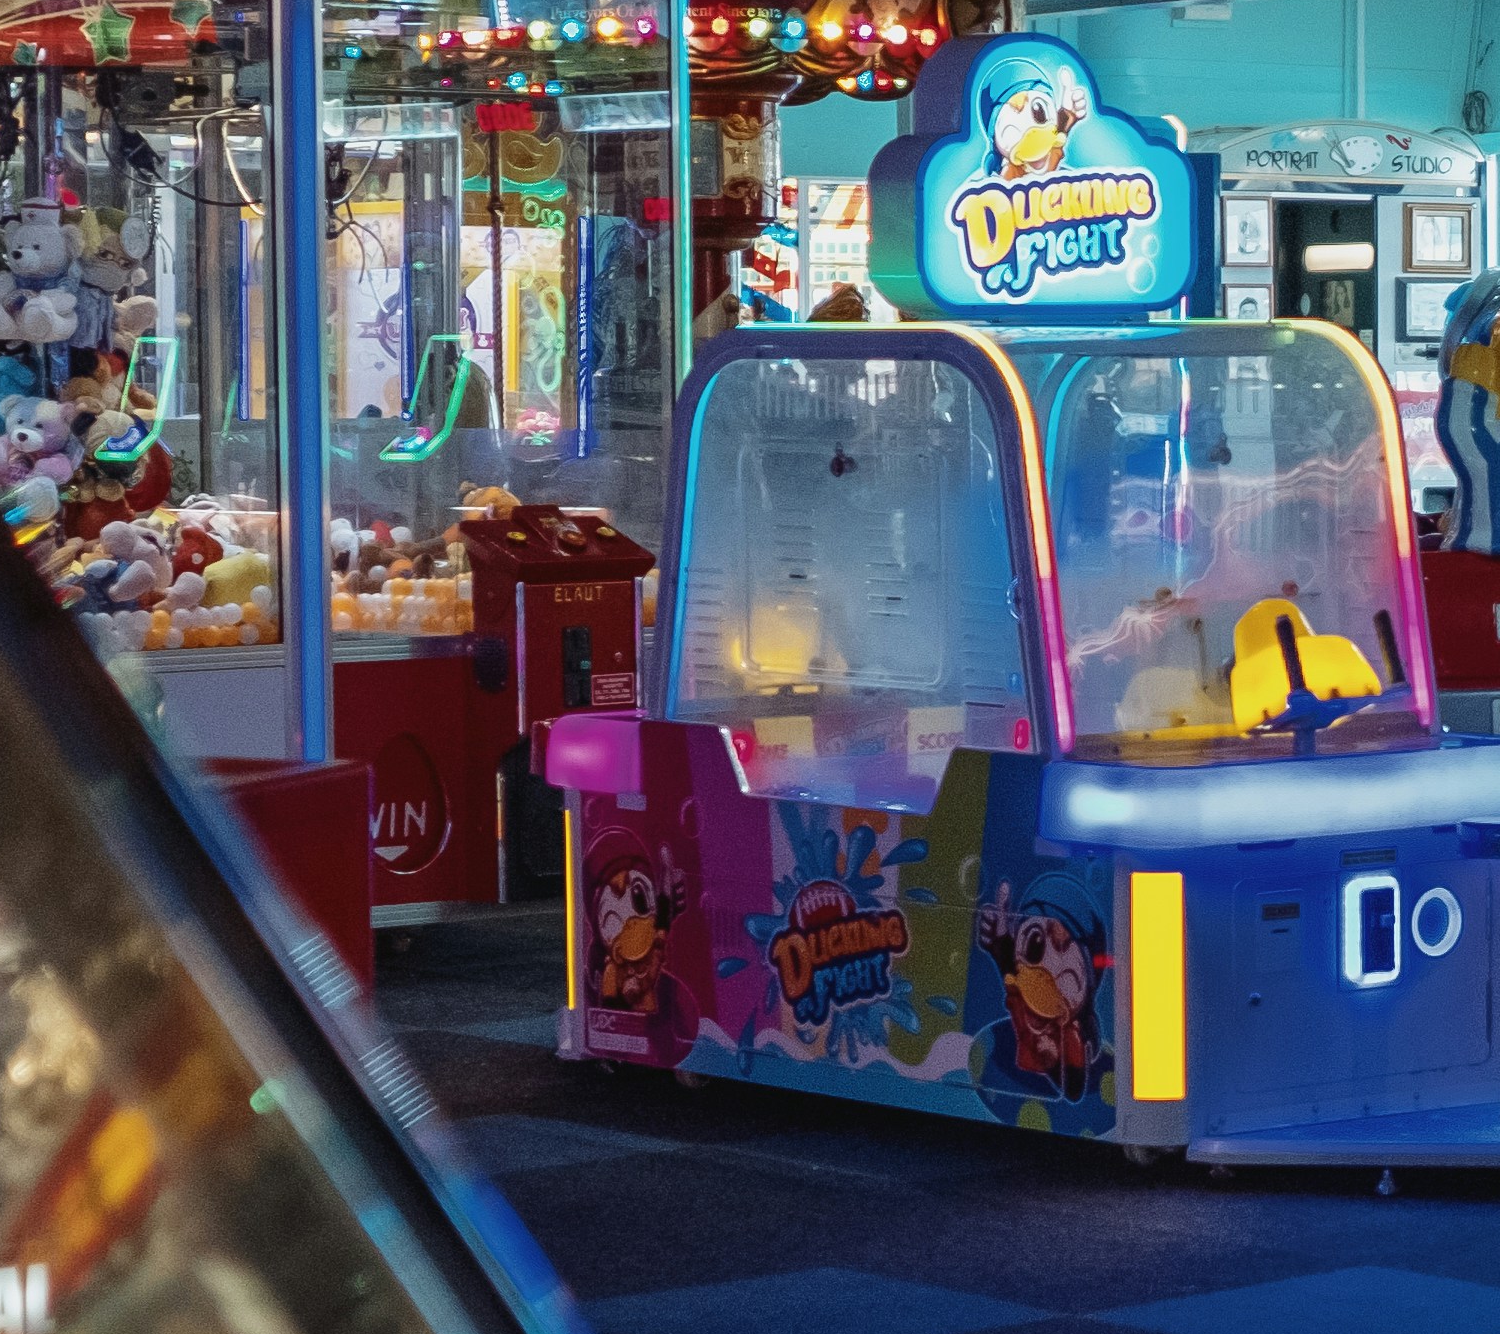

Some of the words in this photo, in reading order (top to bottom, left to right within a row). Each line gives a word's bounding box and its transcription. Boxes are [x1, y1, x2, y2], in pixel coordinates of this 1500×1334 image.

[1246, 150, 1319, 172] PORTRAIT
[1391, 154, 1454, 175] STUDIO
[955, 178, 1152, 268] DUCKLING
[996, 219, 1122, 290] FIGHT
[554, 585, 603, 603] ELAUT
[772, 917, 904, 999] DUCKLING
